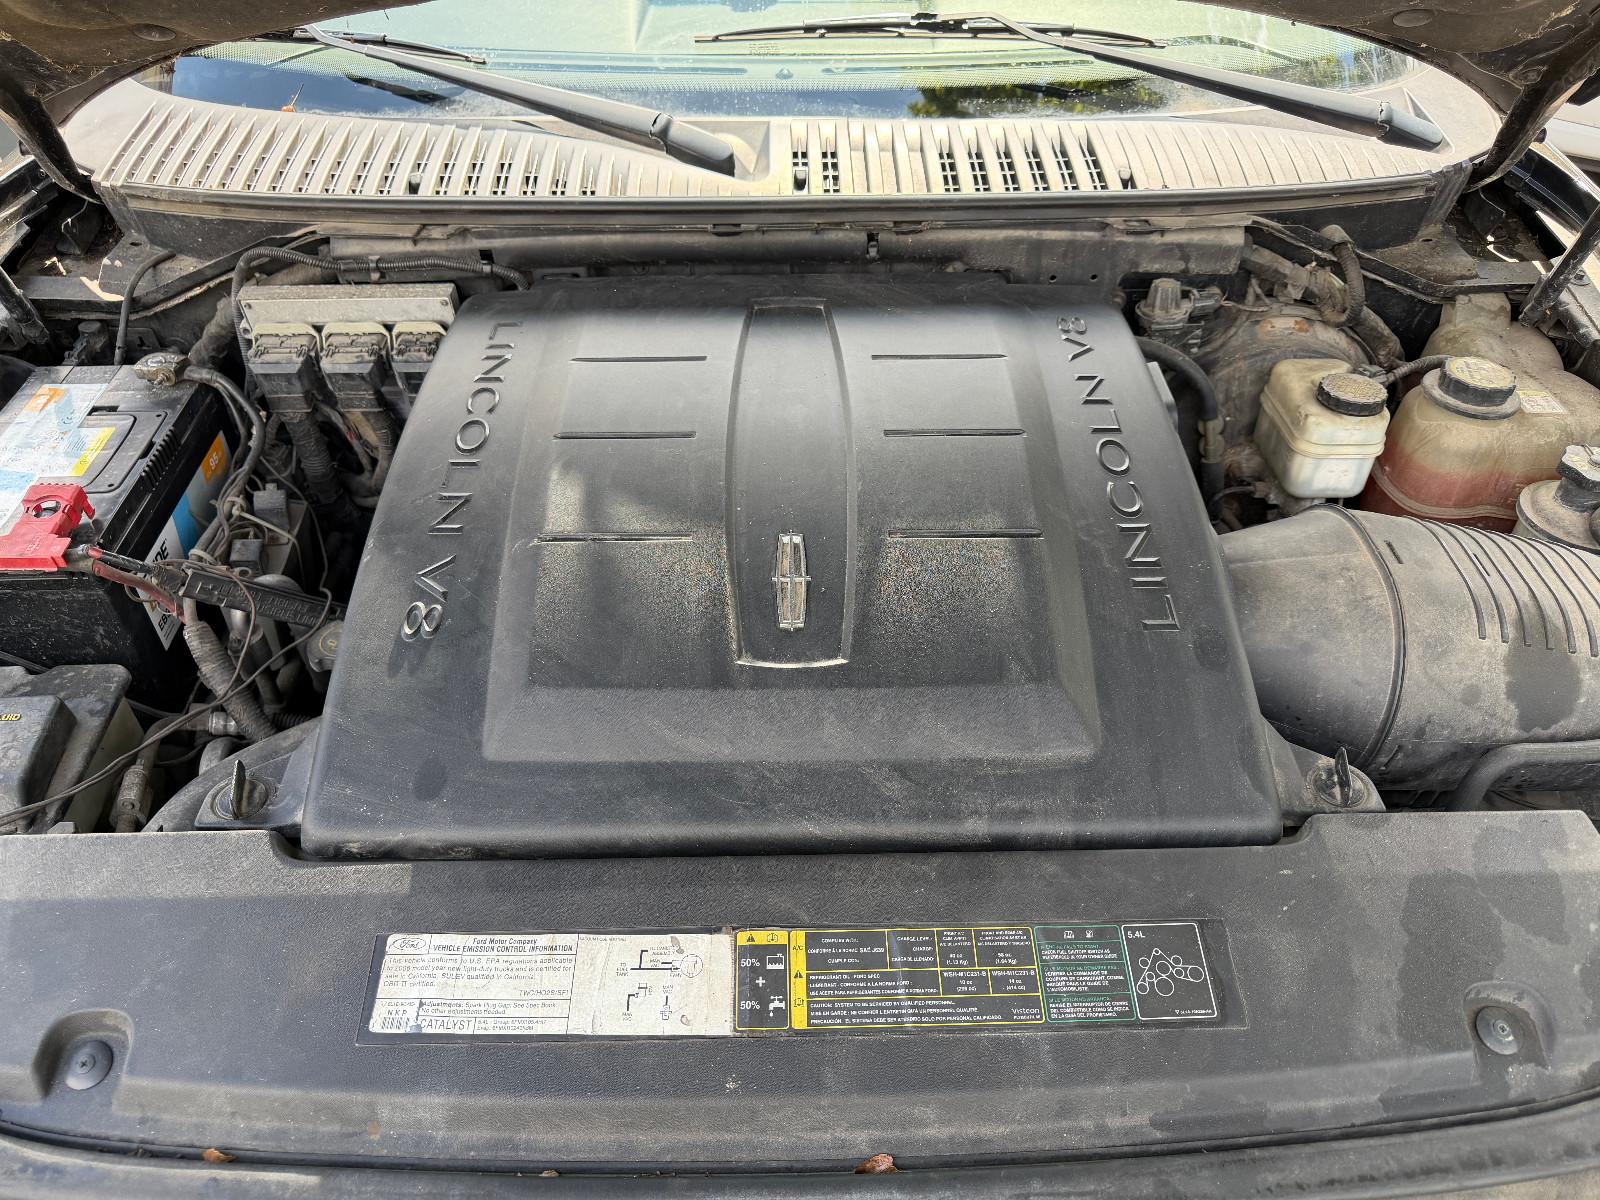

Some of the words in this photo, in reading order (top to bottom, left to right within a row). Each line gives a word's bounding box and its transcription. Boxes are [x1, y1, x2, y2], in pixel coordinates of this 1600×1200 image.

[1056, 315, 1094, 362] V8
[427, 321, 525, 535] LINCOLN
[1074, 372, 1181, 632] LINCOLN
[401, 554, 457, 642] V8
[1128, 930, 1146, 938] 5.4L
[740, 958, 760, 966] 50%
[740, 1000, 760, 1010] 50%
[420, 1018, 472, 1030] CATALYST
